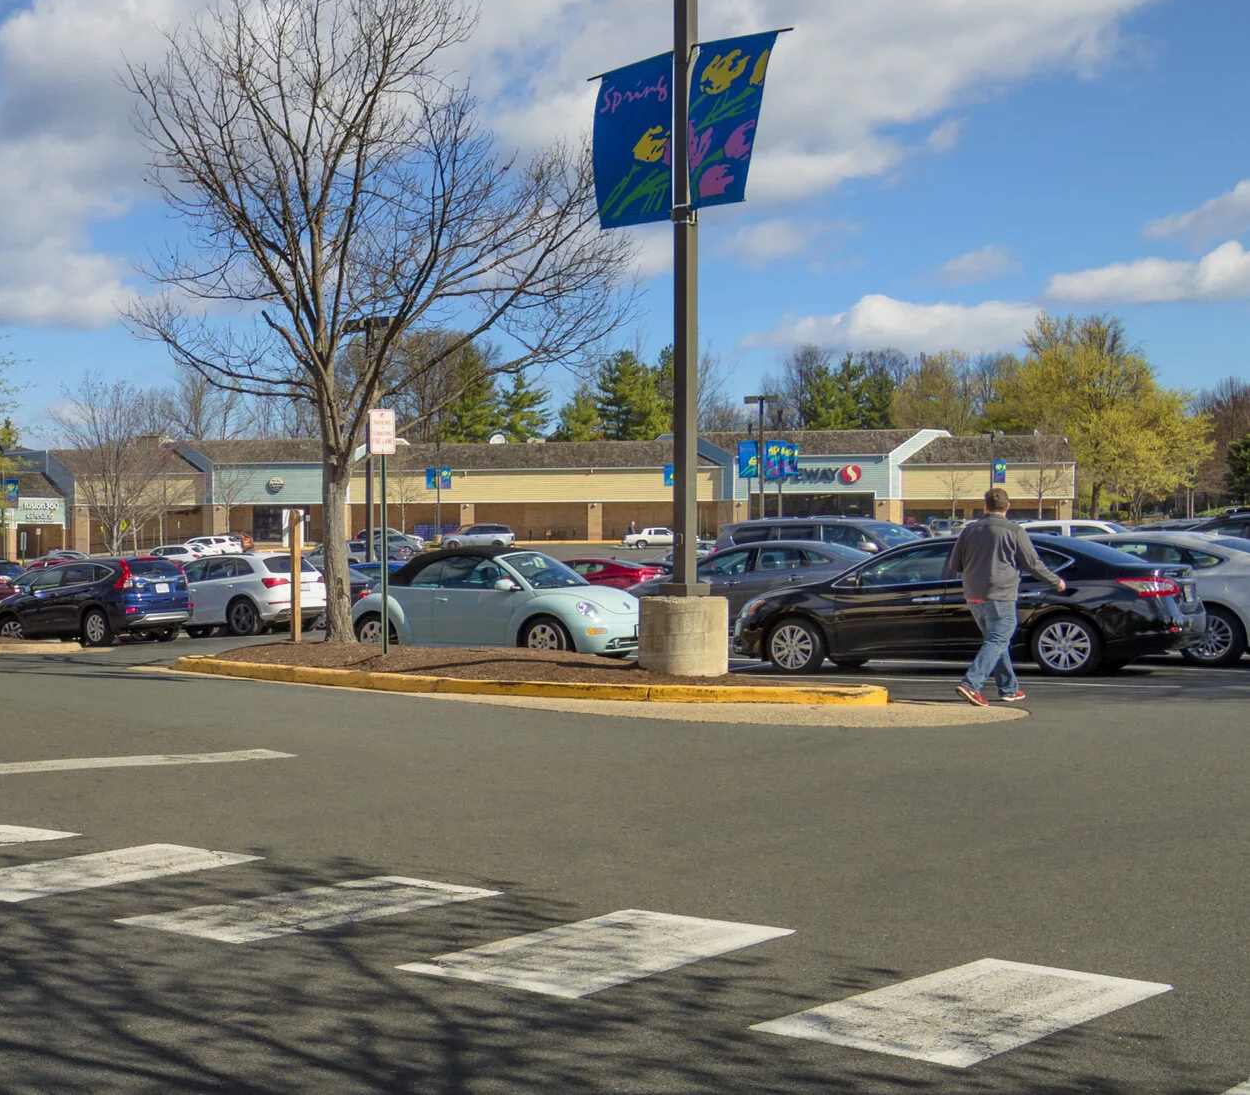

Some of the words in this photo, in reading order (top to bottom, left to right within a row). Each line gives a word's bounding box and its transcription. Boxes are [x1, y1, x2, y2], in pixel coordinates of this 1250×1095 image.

[600, 75, 668, 114] Spring
[763, 467, 840, 485] EWAY
[22, 501, 59, 510] fusion360
